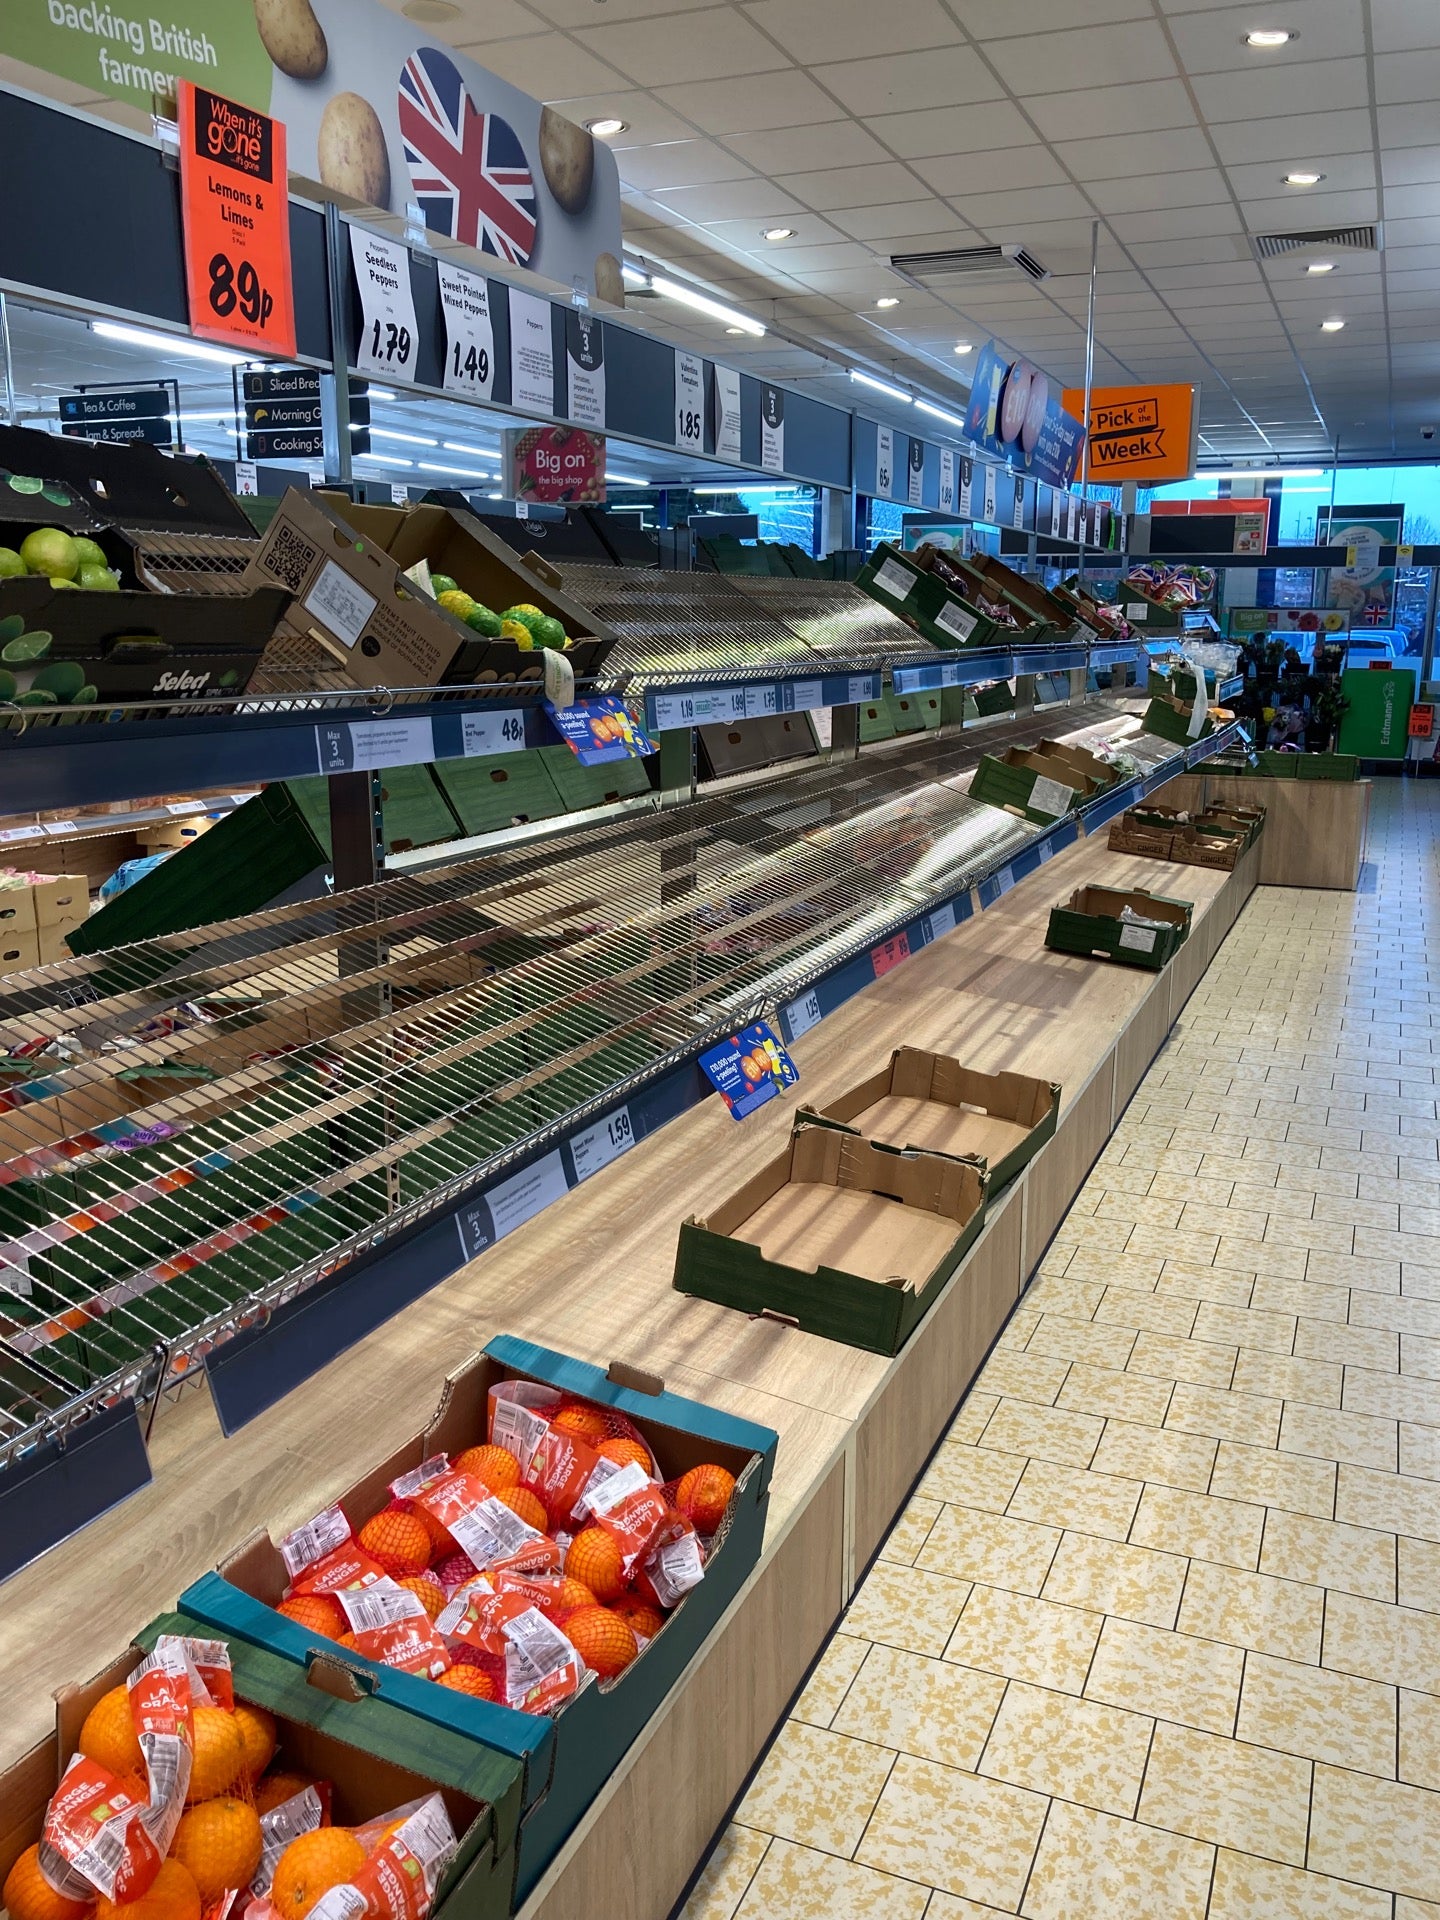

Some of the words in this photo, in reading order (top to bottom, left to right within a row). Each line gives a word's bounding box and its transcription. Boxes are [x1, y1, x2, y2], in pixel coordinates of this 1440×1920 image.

[48, 0, 145, 55] backing
[149, 18, 218, 67] British
[99, 48, 179, 97] farmer
[210, 98, 246, 132] When
[248, 116, 262, 139] it's
[207, 121, 261, 161] gone
[208, 175, 252, 206] Lemons
[255, 194, 264, 211] &
[221, 204, 254, 230] Limes
[365, 251, 398, 273] Seedless
[369, 269, 399, 289] Peppers
[441, 277, 462, 293] Sweet
[462, 284, 486, 302] Pointed
[208, 253, 273, 329] 89p
[443, 293, 463, 310] Mixed
[464, 300, 488, 317] Peppers
[371, 318, 411, 365] 1.79
[582, 333, 589, 352] 3
[453, 341, 489, 384] 1.49
[580, 351, 594, 364] units
[270, 377, 298, 391] Sliced
[298, 377, 320, 389] Brea
[82, 401, 98, 413] Tea
[98, 400, 106, 412] &
[106, 398, 136, 411] Coffee
[271, 408, 312, 423] Morning
[770, 399, 775, 414] 3
[1097, 409, 1135, 430] Pick
[1137, 404, 1146, 414] of
[679, 408, 701, 440] 1.85
[1138, 414, 1152, 423] the
[102, 428, 110, 440] &
[110, 425, 145, 442] Spreads
[273, 437, 313, 453] Cooking
[1098, 437, 1152, 461] Week
[535, 449, 562, 473] Big
[564, 453, 586, 469] on
[538, 475, 550, 485] the
[551, 475, 564, 487] big
[564, 476, 583, 487] shop
[152, 669, 211, 692] Select
[680, 699, 693, 719] 1.19
[327, 731, 341, 741] Max
[502, 717, 524, 741] 48p
[331, 740, 339, 757] 3
[329, 757, 345, 768] units
[1137, 845, 1164, 854] GINGER
[1200, 855, 1228, 864] GINGER
[607, 1113, 631, 1146] 1.59
[467, 1210, 481, 1223] Max
[472, 1220, 481, 1238] 3
[473, 1236, 488, 1250] units
[544, 1446, 574, 1492] ORANGES
[559, 1456, 578, 1490] LARGE
[624, 1510, 653, 1536] LARGE
[312, 1561, 362, 1592] ORANGES
[315, 1561, 350, 1586] LARGE
[378, 1640, 434, 1666] ORANGES
[383, 1637, 422, 1656] LARGE
